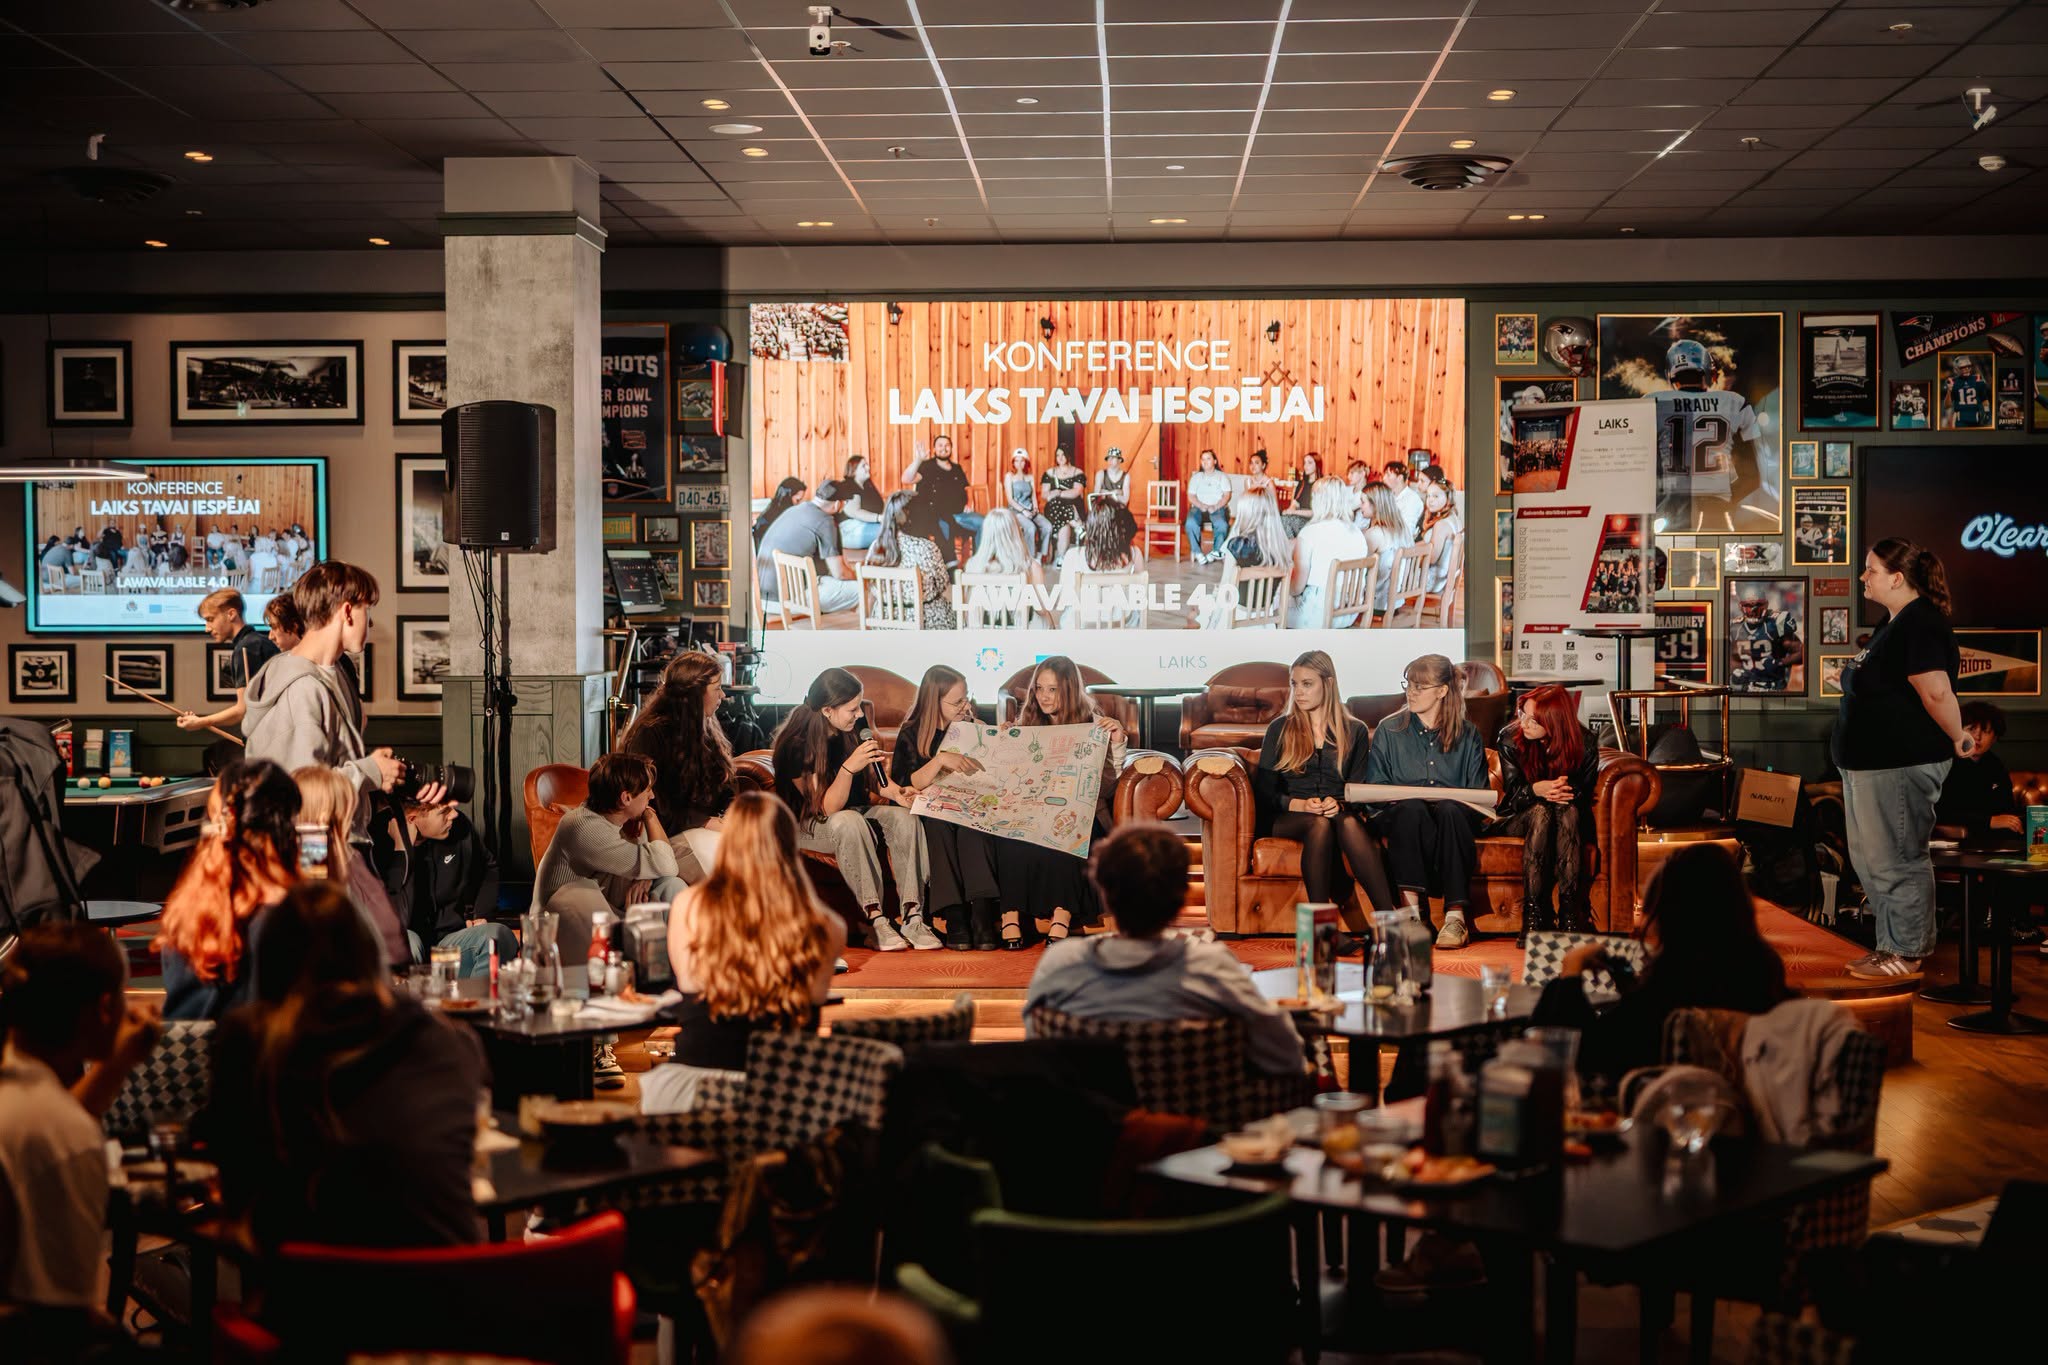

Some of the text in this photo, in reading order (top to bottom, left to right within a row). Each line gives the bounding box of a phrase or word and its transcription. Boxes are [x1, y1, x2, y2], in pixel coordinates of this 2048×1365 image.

[1904, 317, 1986, 360] CHAMPIONS
[983, 340, 1230, 372] KONFERENCE
[617, 387, 652, 402] BOWL
[889, 377, 1324, 425] LAIKS TAVAI IESPĒJAI
[1958, 388, 1978, 405] 12
[1674, 397, 1719, 413] BRADY
[1599, 418, 1629, 430] LAIKS
[1663, 415, 1730, 476] 12
[127, 481, 224, 495] KONFERENCE
[91, 496, 260, 516] LAIKS TAVAI IESPĒJAI
[1961, 513, 2048, 558] O'Lear
[116, 576, 229, 589] LAWAVAILABLE 4.0
[1187, 583, 1240, 611] 4.0
[1656, 616, 1705, 629] MARONEY
[1659, 630, 1699, 659] 39
[1159, 655, 1208, 669] LAIKS
[1960, 659, 1993, 675] RIOTS
